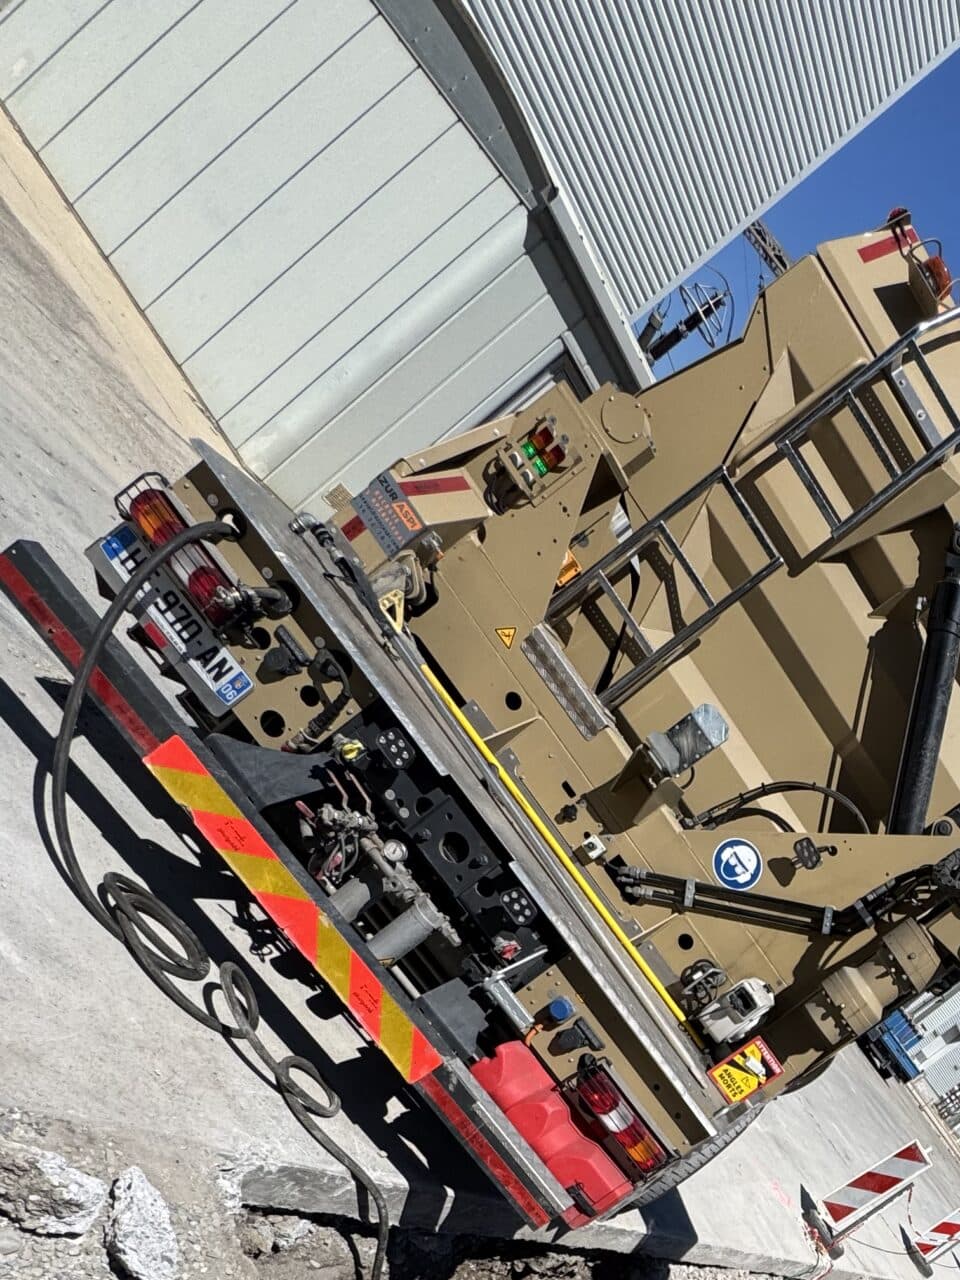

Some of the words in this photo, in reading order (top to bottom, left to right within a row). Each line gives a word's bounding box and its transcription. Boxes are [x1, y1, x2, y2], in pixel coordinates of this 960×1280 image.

[376, 474, 399, 501] ZUR
[396, 503, 418, 529] ASPI
[221, 684, 238, 700] 06
[754, 1040, 782, 1074] ATTENTION
[718, 1072, 739, 1098] MORTS
[723, 1068, 745, 1095] ANGLES
